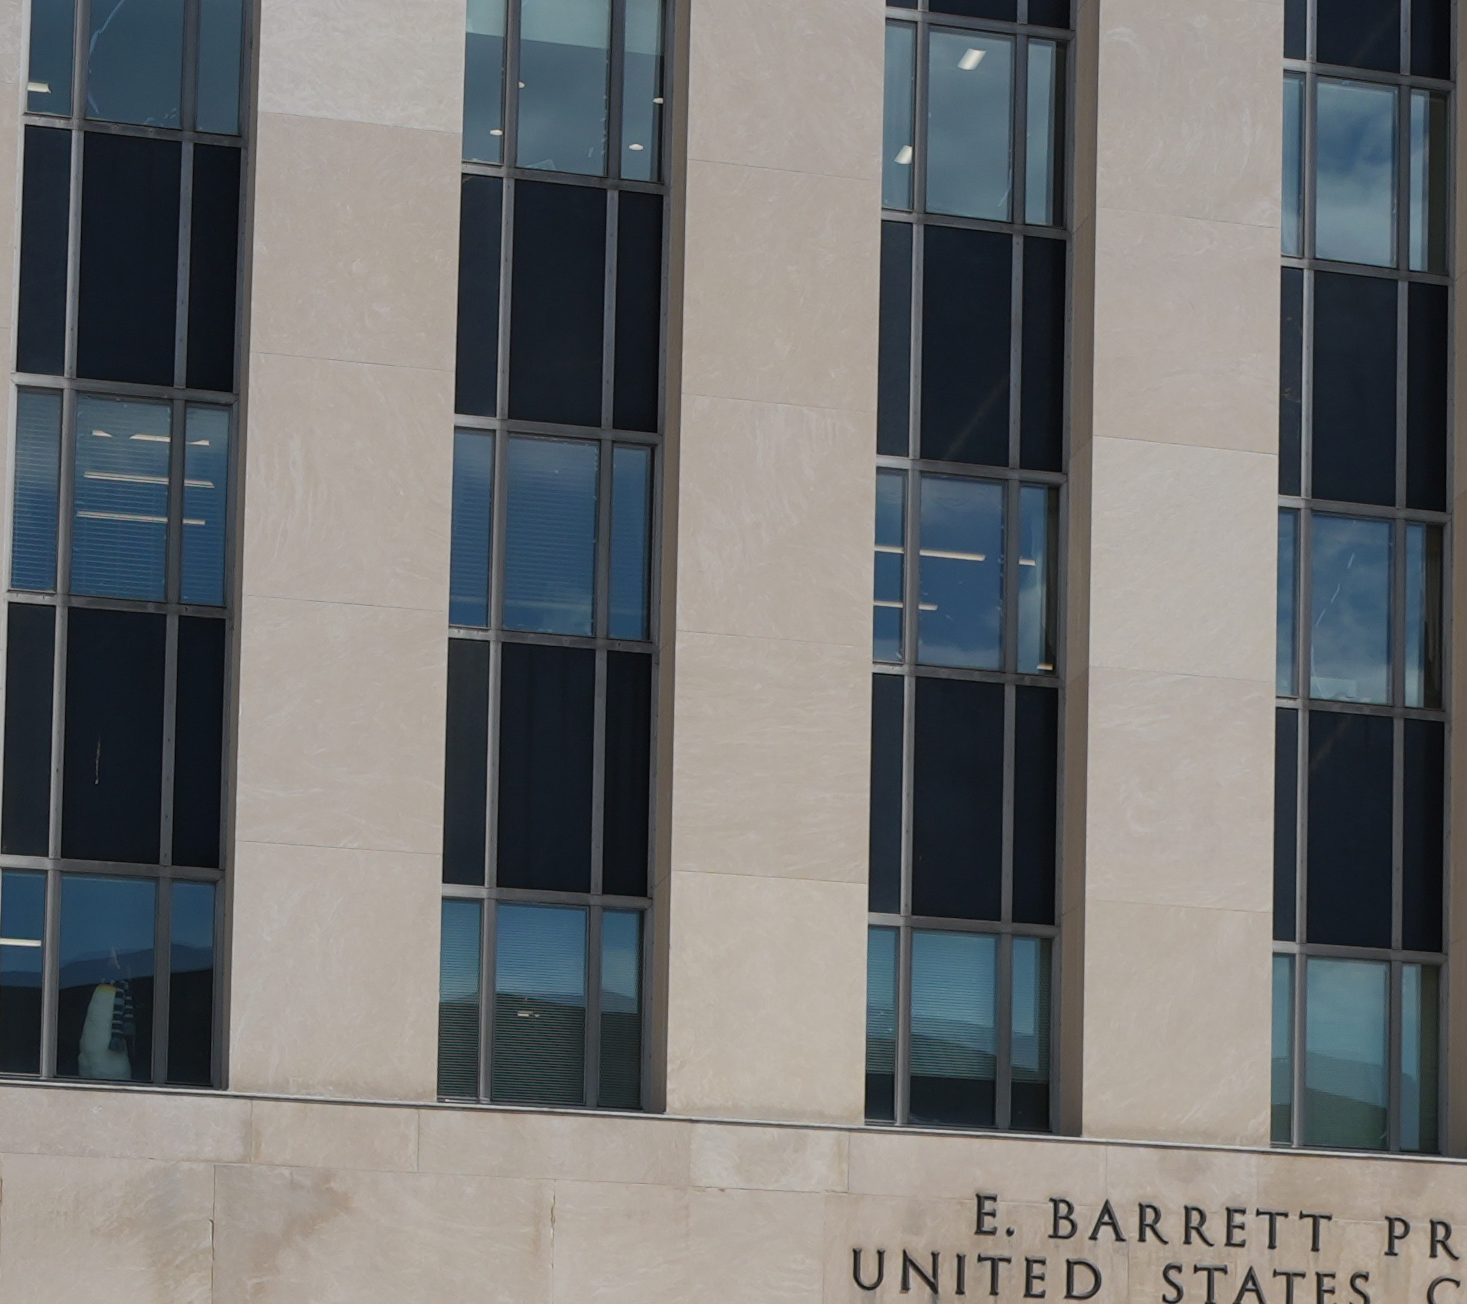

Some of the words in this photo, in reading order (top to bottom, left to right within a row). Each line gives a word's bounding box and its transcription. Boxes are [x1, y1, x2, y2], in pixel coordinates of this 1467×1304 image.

[974, 1193, 1015, 1238] E.
[1049, 1197, 1332, 1252] BARRETT
[852, 1248, 1102, 1300] UNITED
